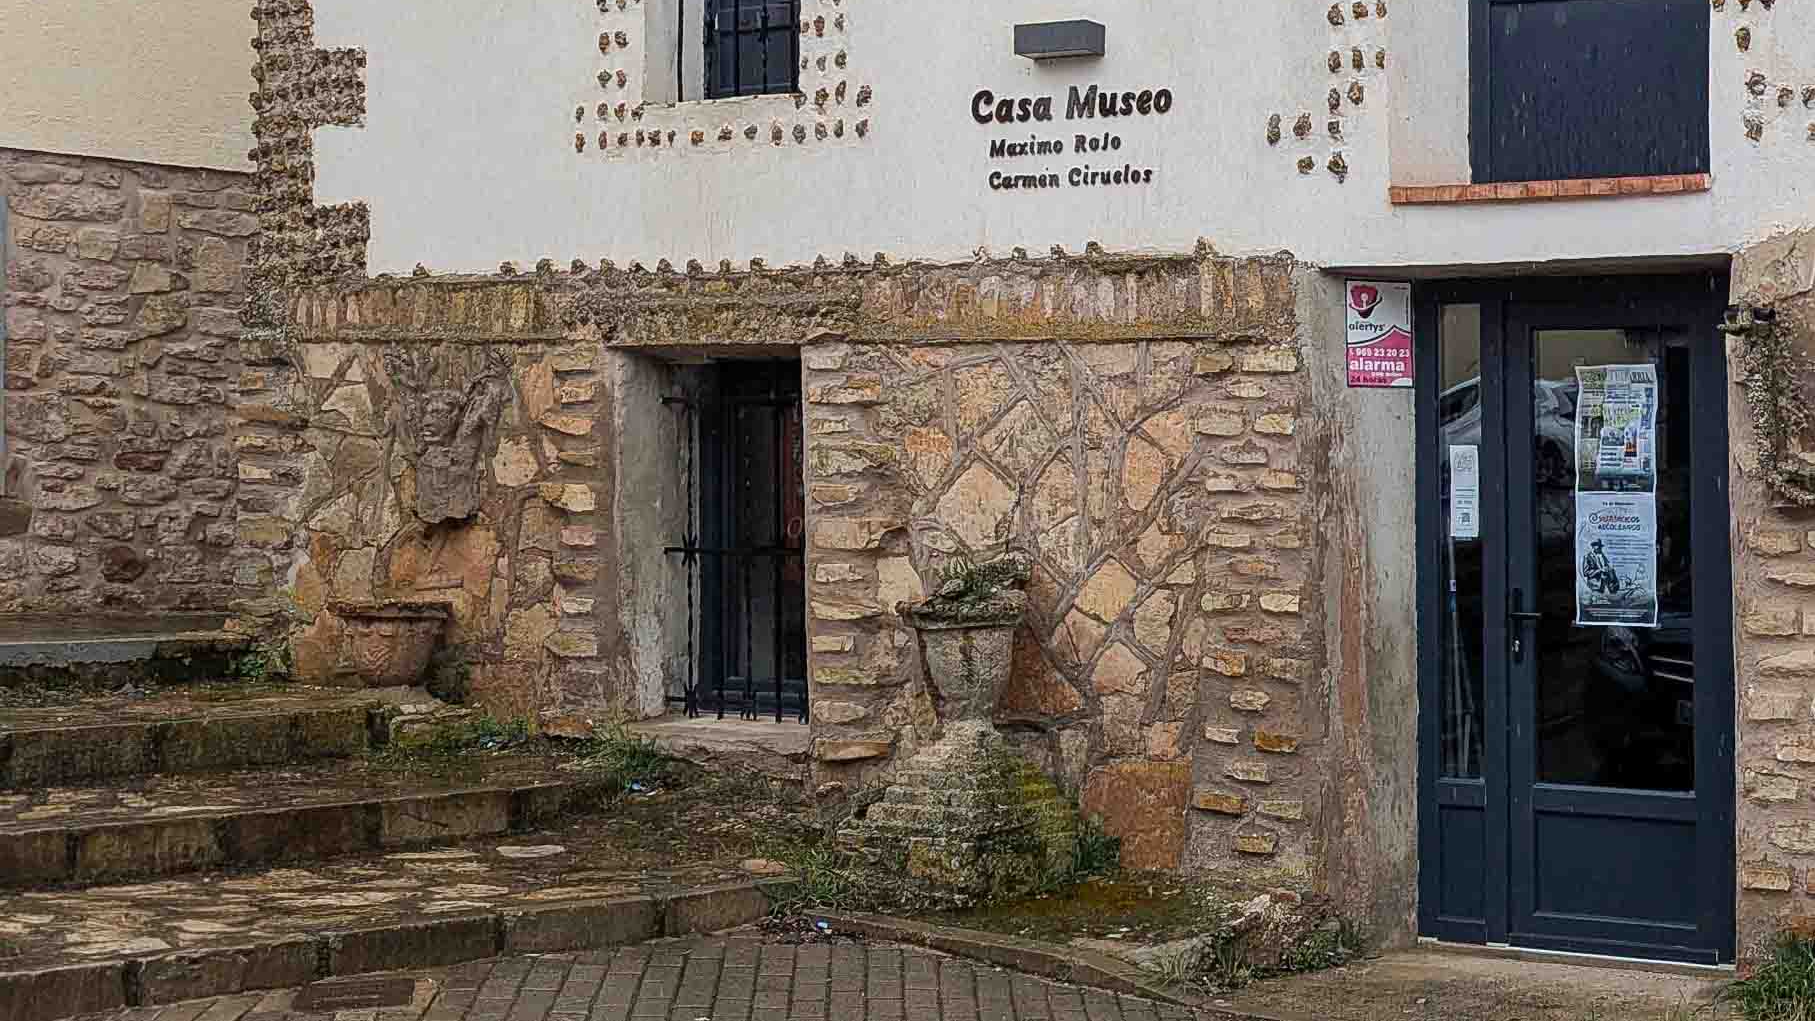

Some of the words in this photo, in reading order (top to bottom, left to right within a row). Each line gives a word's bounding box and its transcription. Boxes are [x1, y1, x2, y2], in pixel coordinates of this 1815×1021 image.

[971, 89, 1053, 124] Casa
[1065, 84, 1173, 120] Museo
[989, 134, 1064, 158] Maximo
[1068, 163, 1153, 187] Ciruelos
[1349, 357, 1405, 372] alarma
